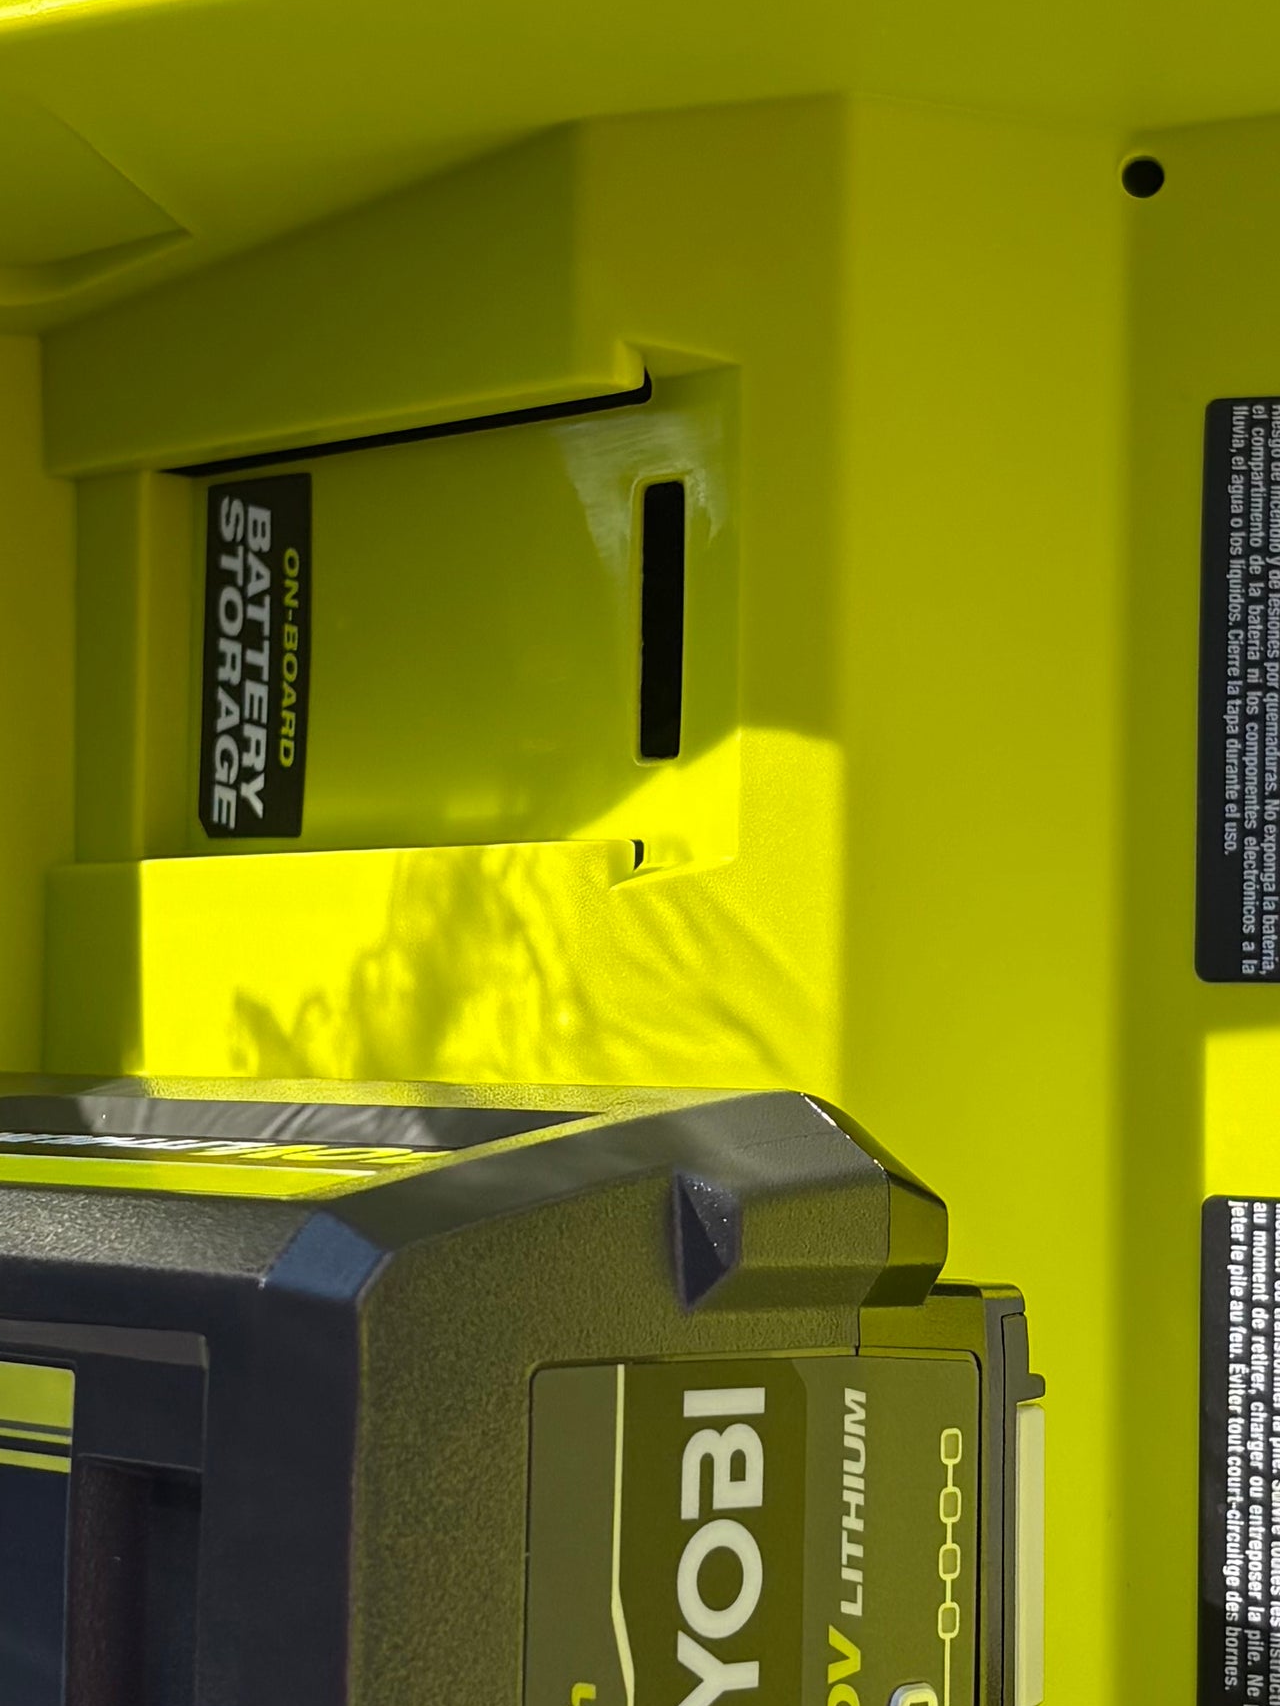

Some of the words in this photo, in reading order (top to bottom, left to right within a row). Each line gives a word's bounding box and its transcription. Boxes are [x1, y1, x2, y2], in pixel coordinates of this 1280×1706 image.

[212, 496, 244, 829] STORAGE
[240, 505, 272, 819] BATTERY
[279, 547, 300, 767] ON-BOARD
[840, 1387, 867, 1617] LITHIUM
